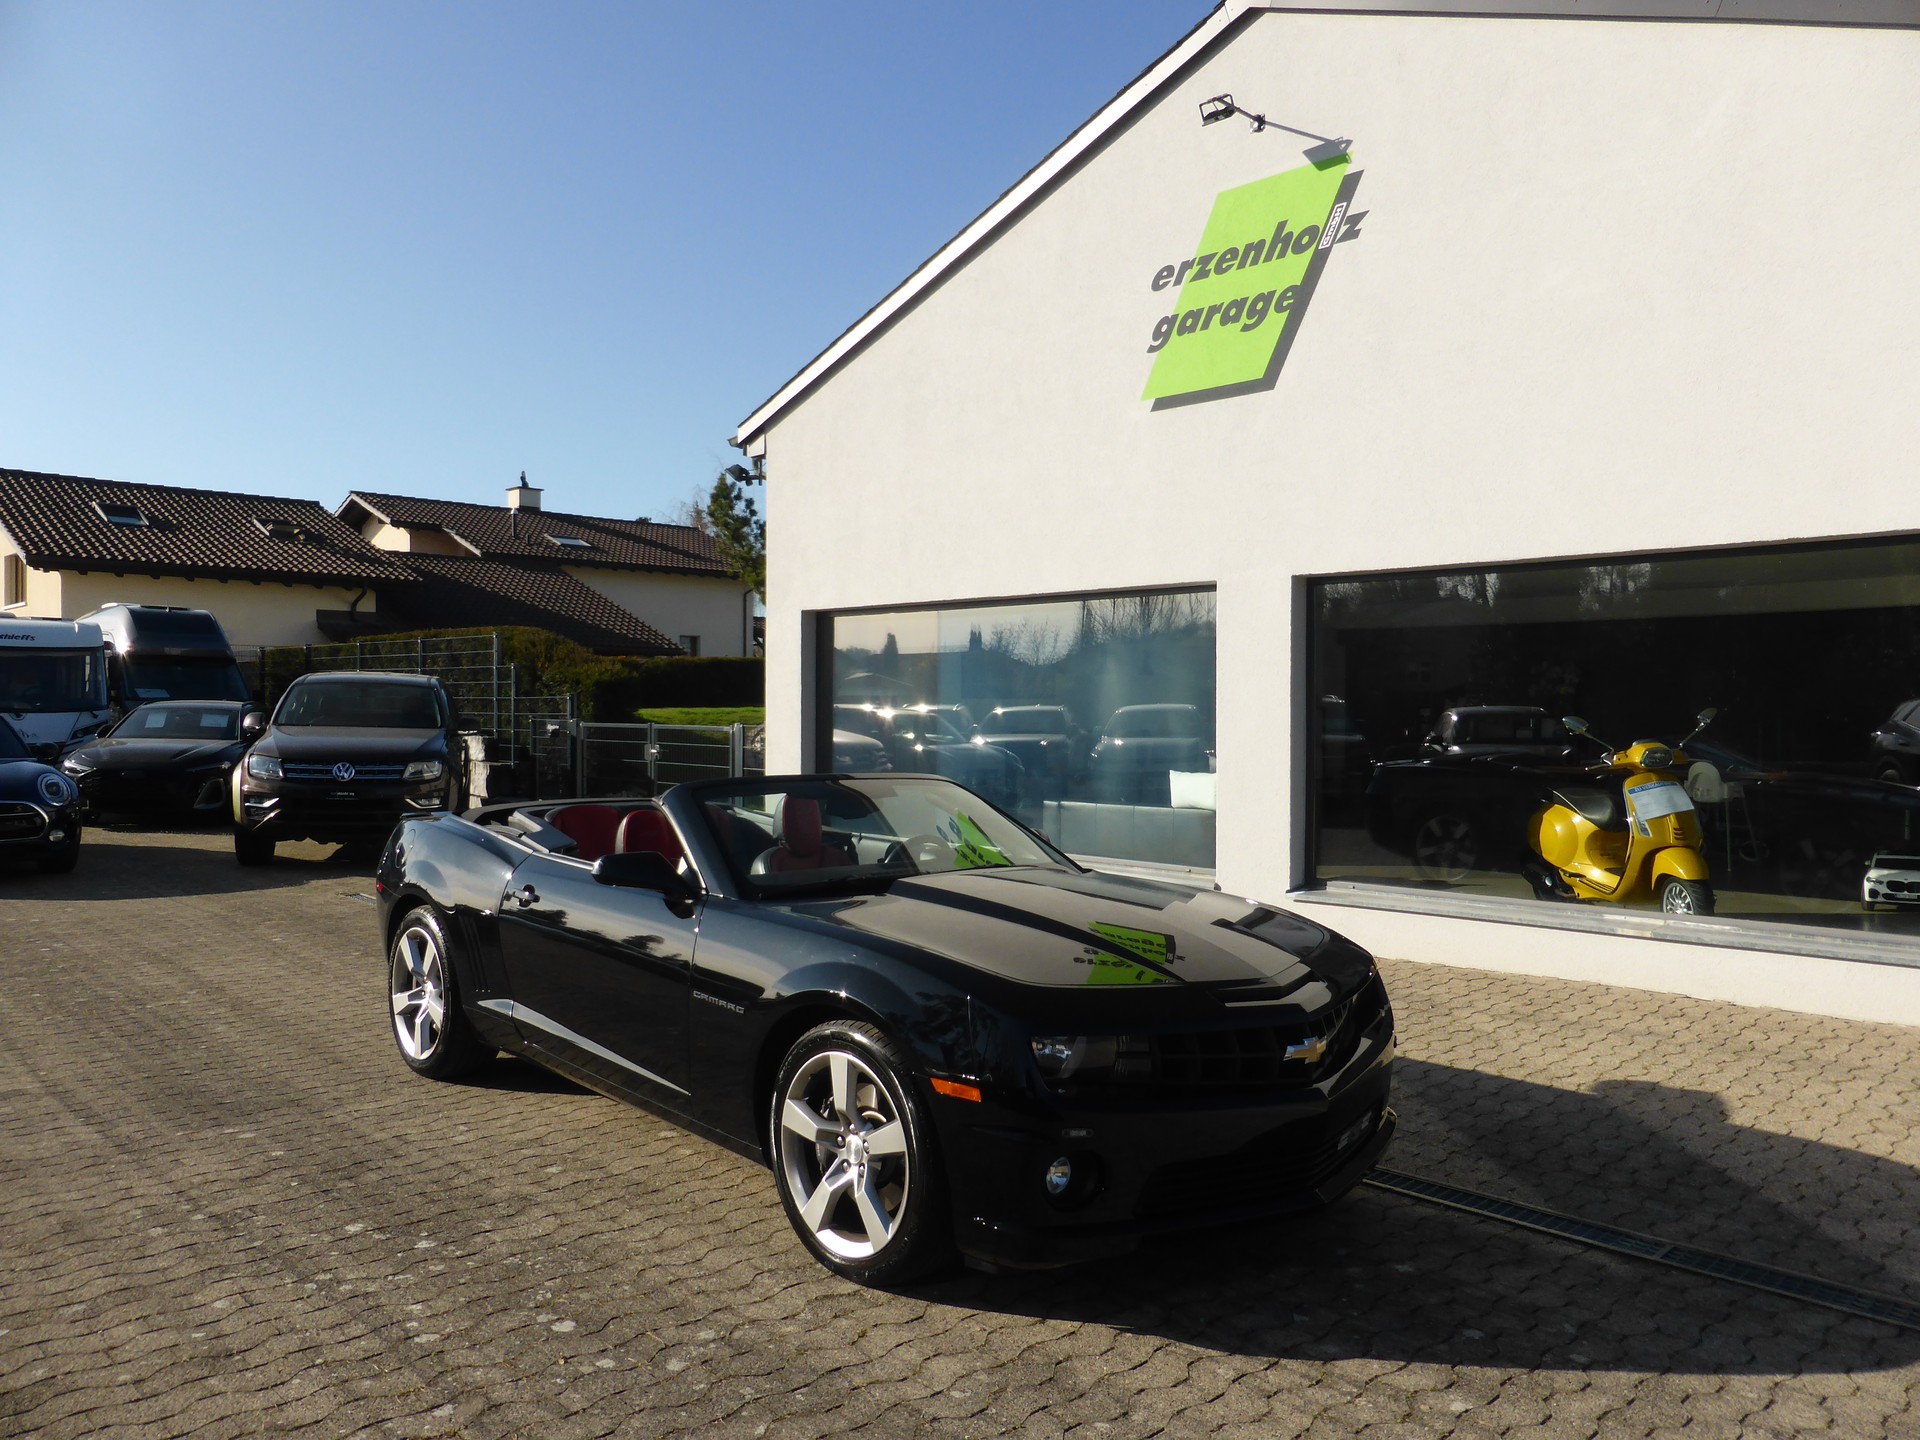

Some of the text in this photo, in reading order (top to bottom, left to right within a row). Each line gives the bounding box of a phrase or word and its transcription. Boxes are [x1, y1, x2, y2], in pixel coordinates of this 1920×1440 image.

[1150, 208, 1370, 292] erzenholz
[1321, 206, 1344, 247] GmbH
[1146, 284, 1301, 353] garage
[693, 990, 745, 1014] CAMARO
